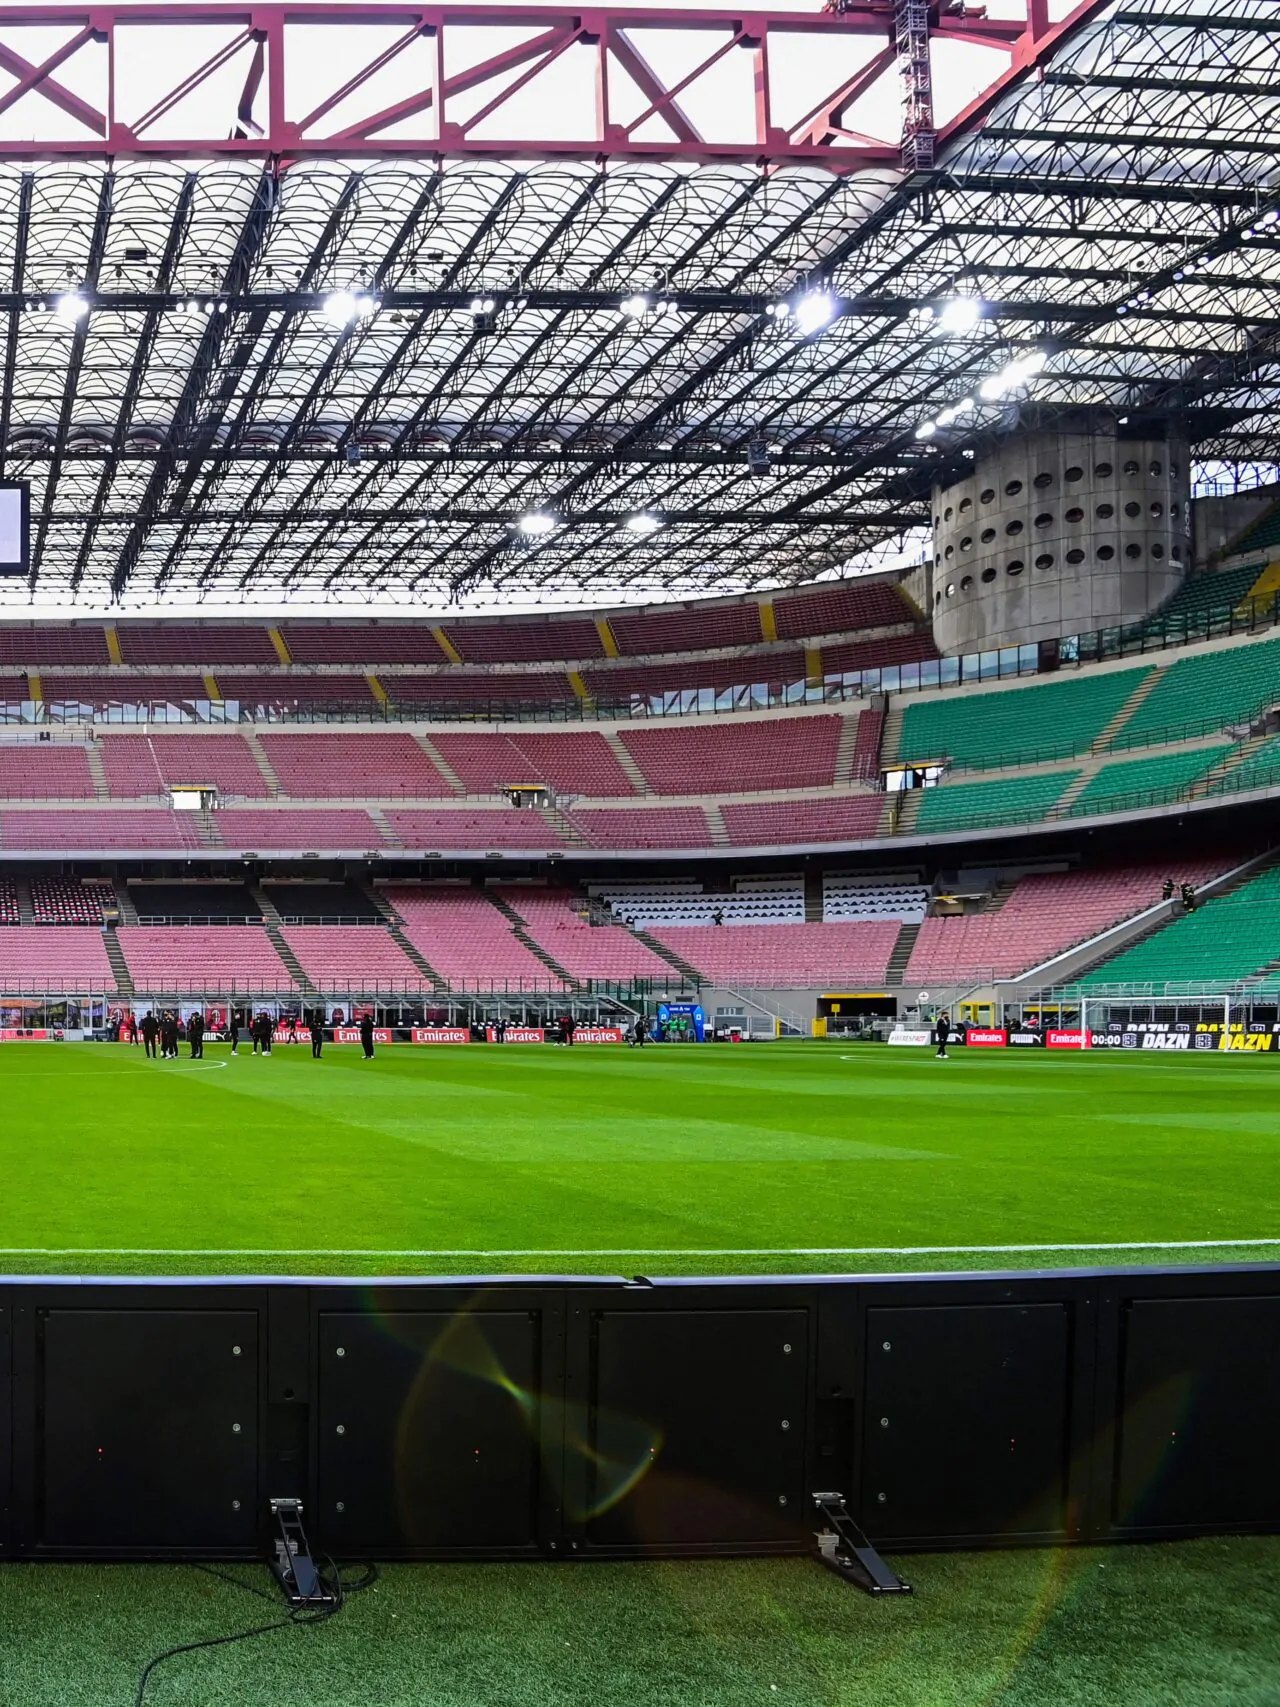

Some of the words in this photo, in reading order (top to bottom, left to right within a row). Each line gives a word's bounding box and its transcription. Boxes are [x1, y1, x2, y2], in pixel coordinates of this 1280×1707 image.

[339, 1030, 387, 1041] Emites
[416, 1030, 465, 1041] Emirates
[970, 1033, 1003, 1042] Emirates
[1091, 1034, 1121, 1045] 00:00
[1142, 1033, 1191, 1049] DAZN
[1218, 1034, 1273, 1050] DAZN
